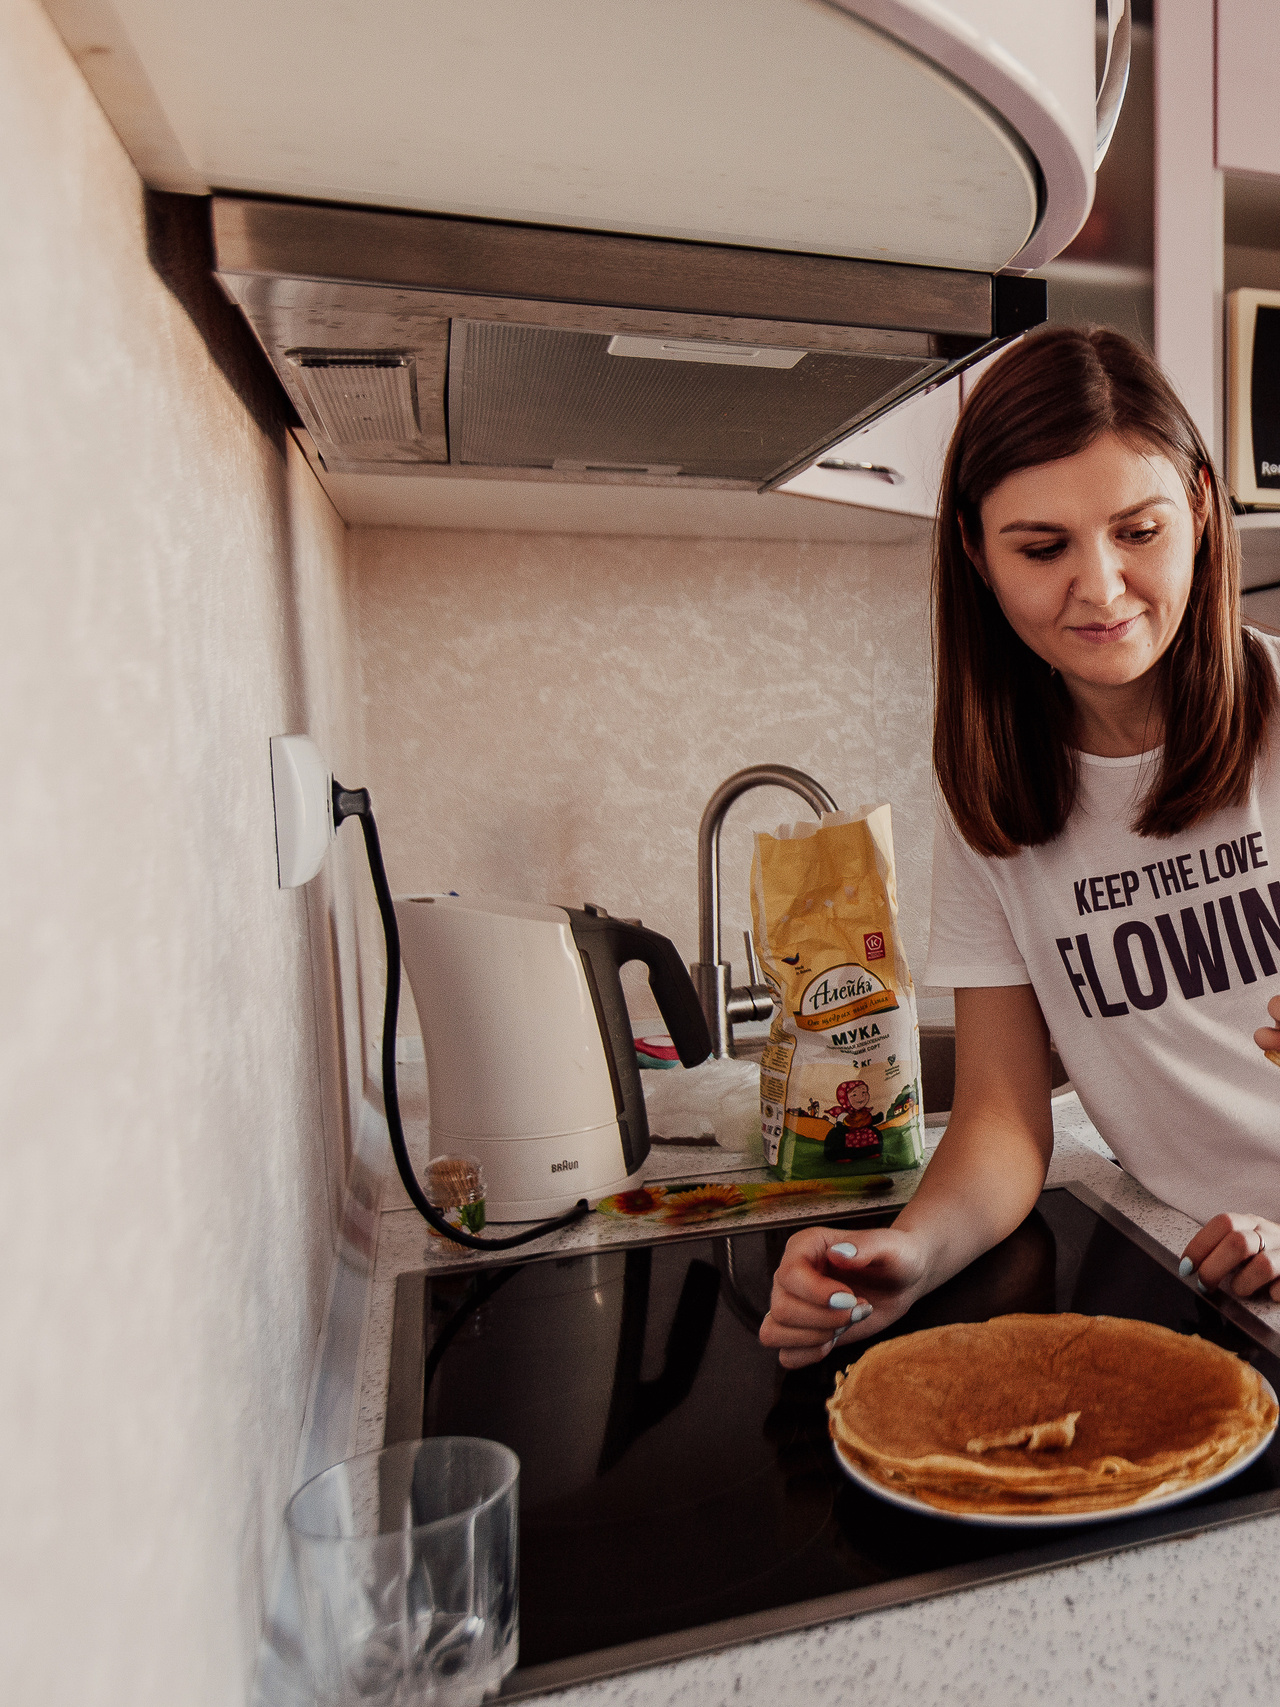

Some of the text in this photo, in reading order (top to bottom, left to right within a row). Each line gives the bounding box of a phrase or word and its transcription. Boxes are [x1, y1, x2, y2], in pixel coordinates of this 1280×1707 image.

[1074, 831, 1268, 916] KEEP THE LOVE
[809, 975, 873, 1010] Алейка
[831, 1023, 881, 1046] МУКА
[551, 1159, 579, 1173] BRAUN
